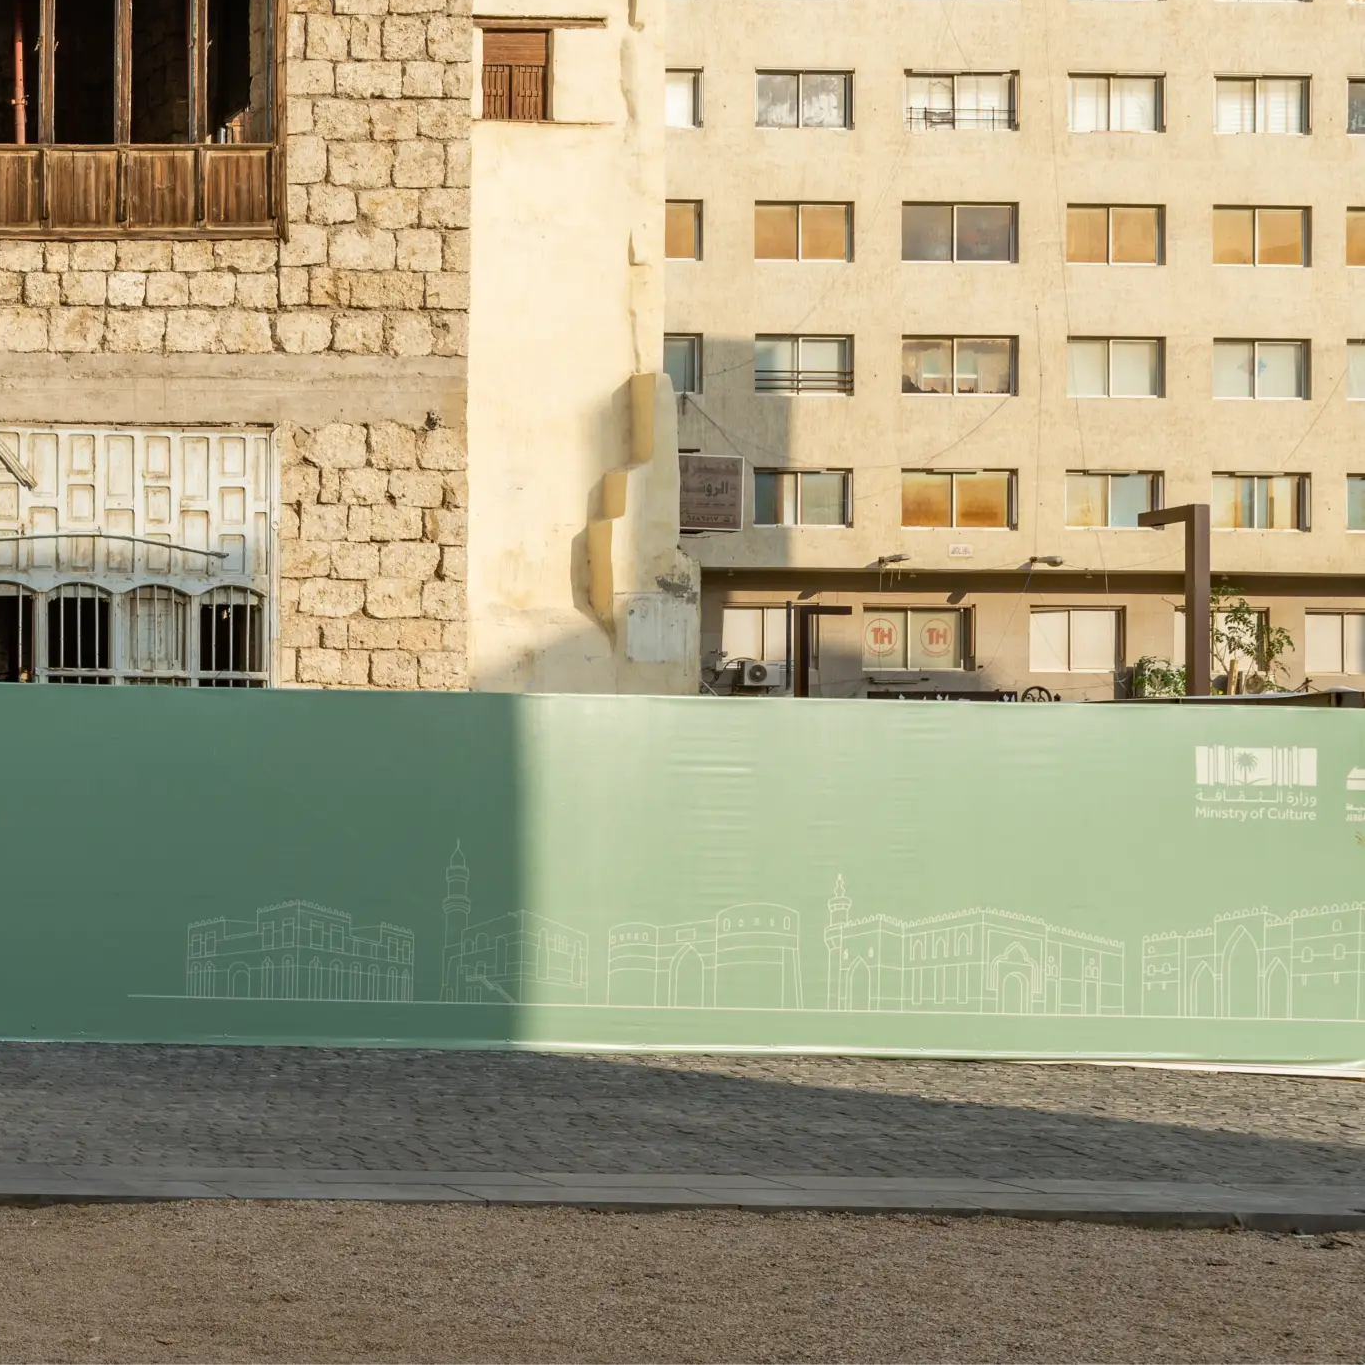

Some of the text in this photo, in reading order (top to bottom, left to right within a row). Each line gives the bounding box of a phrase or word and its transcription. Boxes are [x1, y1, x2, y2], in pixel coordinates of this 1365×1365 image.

[1195, 788, 1317, 807] وزارة الثقافة
[1194, 805, 1317, 822] Ministry of Culture
